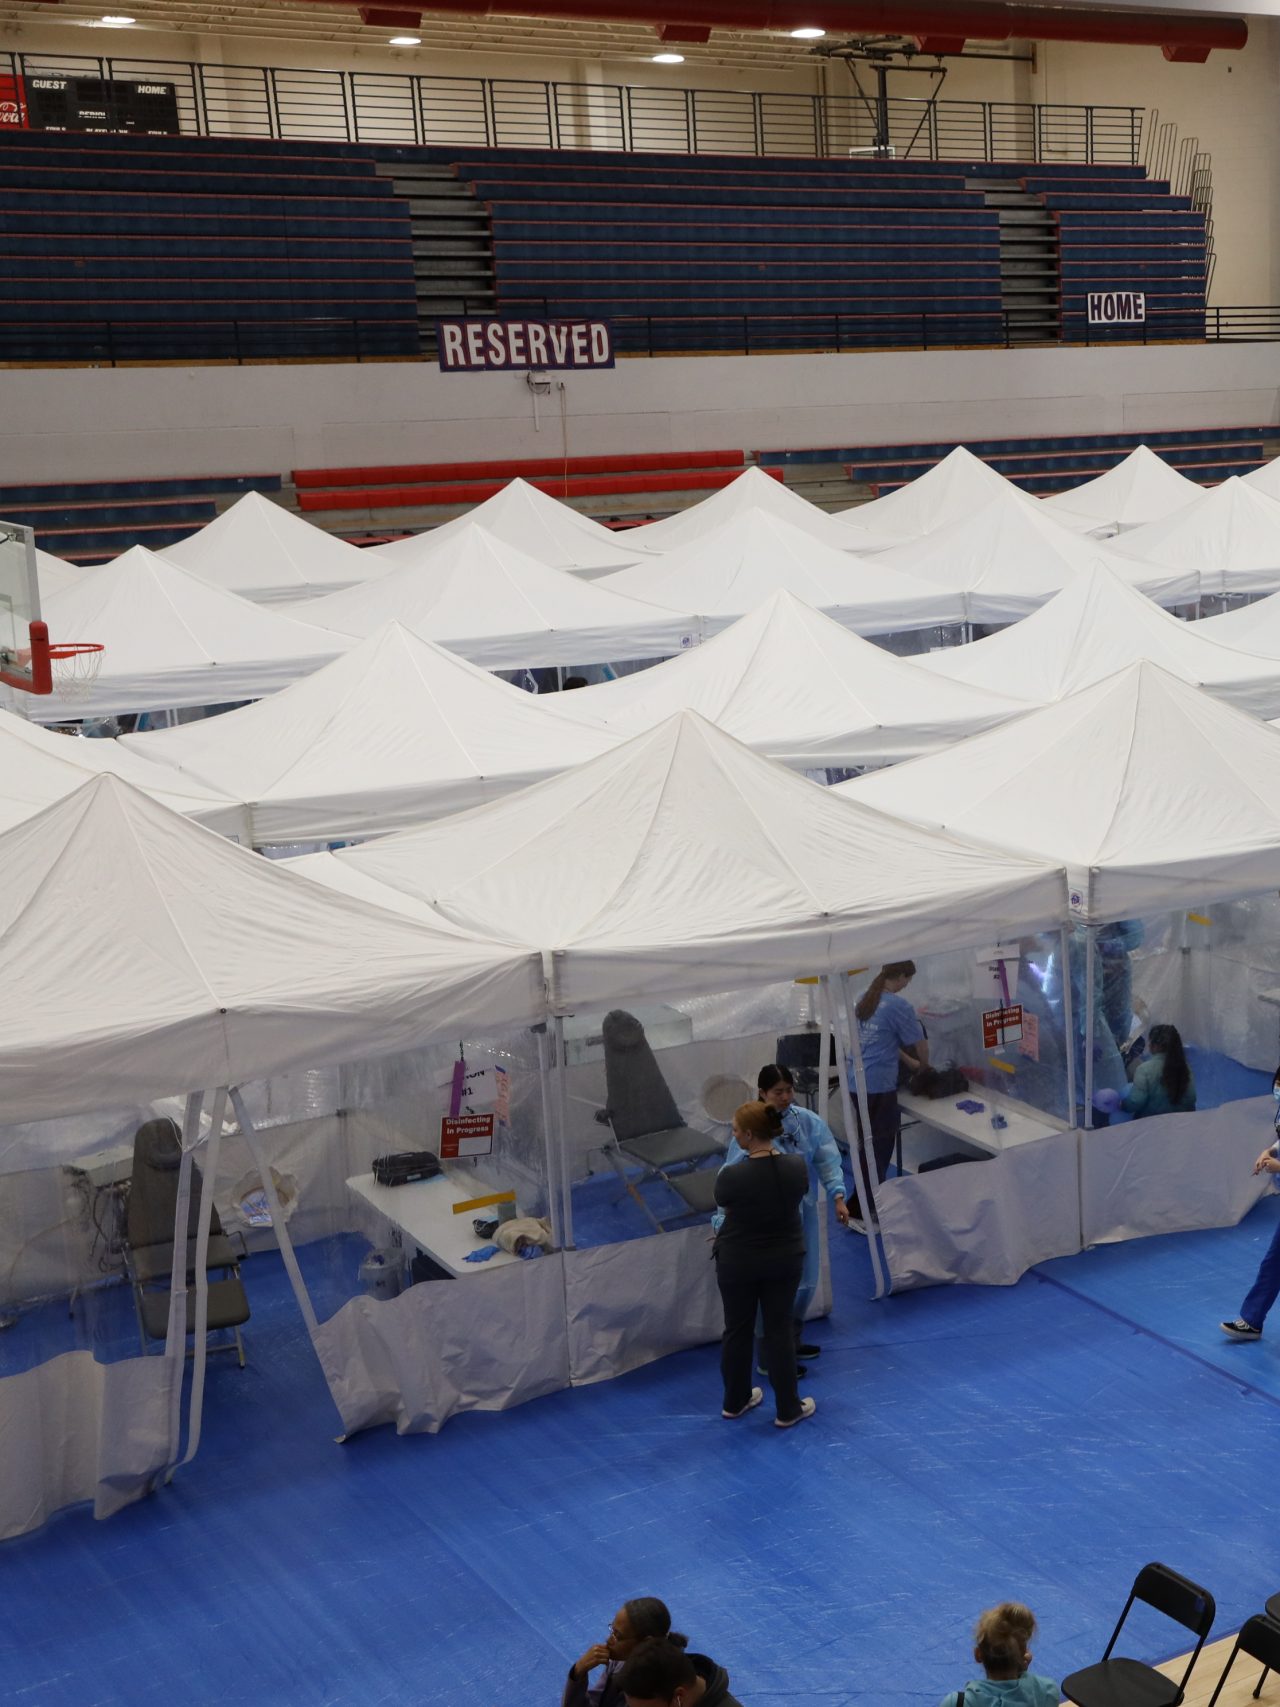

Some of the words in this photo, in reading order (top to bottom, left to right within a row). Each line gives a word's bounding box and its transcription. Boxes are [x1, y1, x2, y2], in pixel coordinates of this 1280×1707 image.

[32, 79, 67, 90] GUEST
[138, 85, 167, 94] HOME
[1090, 294, 1143, 320] HOME
[443, 323, 609, 366] RESERVED
[446, 1116, 491, 1126] Disinfecting
[456, 1126, 489, 1134] Progress
